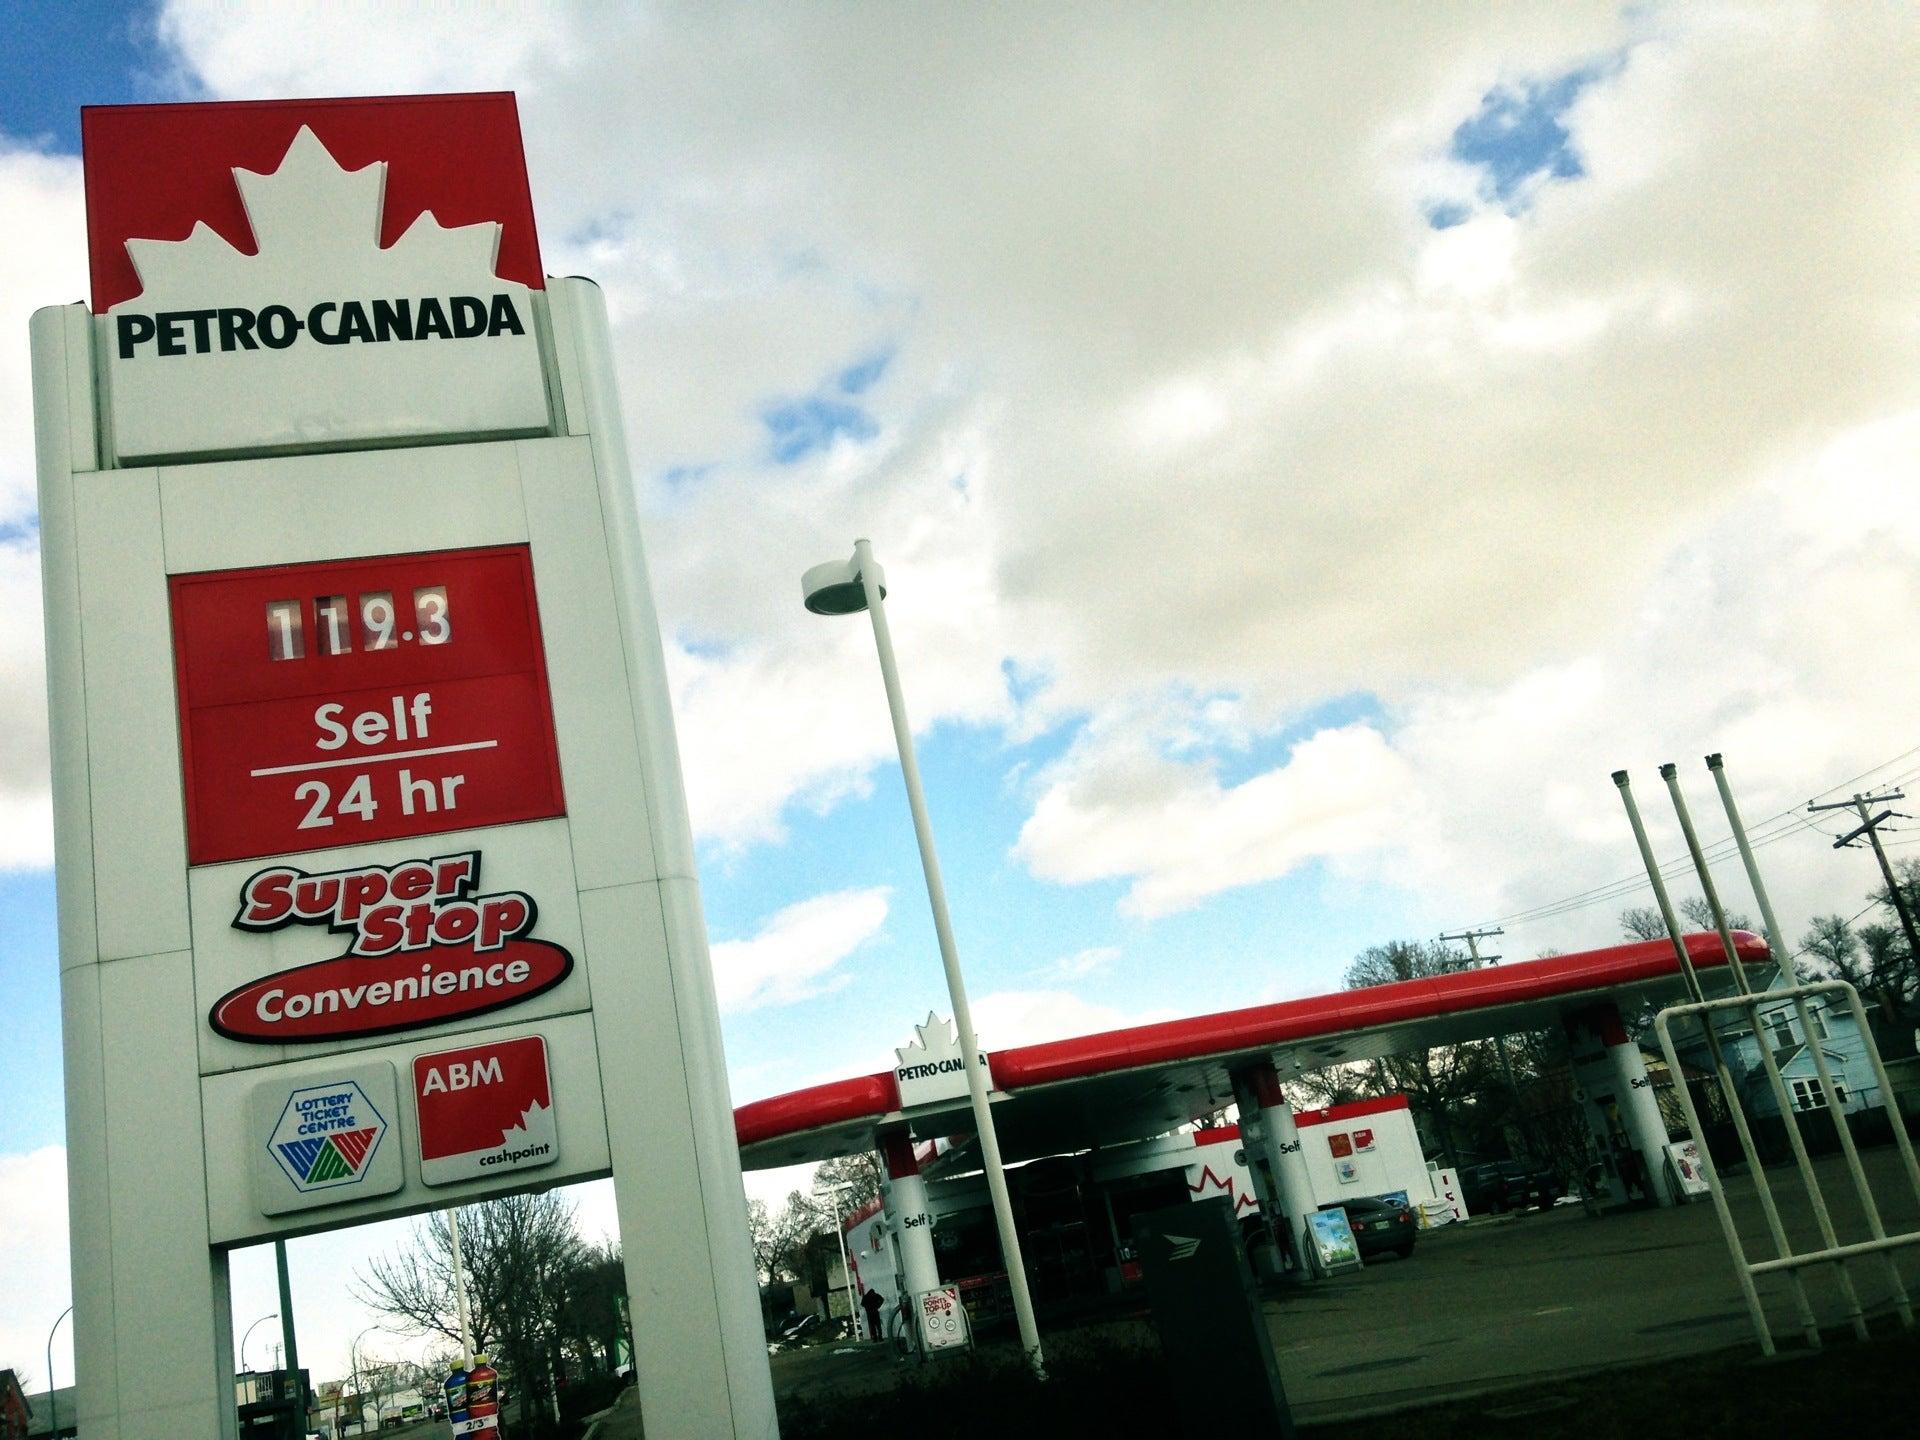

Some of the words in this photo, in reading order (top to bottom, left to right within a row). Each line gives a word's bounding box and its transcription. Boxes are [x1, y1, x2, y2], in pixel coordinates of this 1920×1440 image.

[117, 294, 525, 359] PETRO-CANADA
[272, 593, 450, 660] 119.3
[314, 692, 432, 751] Self
[294, 774, 378, 830] 24
[399, 769, 465, 816] hr
[244, 857, 471, 924] Super
[358, 897, 528, 952] Stop
[256, 959, 530, 1022] Convenience
[423, 1056, 503, 1096] ABM
[295, 1092, 354, 1112] LOTTERY
[301, 1105, 349, 1122] TICKET
[298, 1116, 355, 1135] CENTRE
[479, 1143, 551, 1167] cashpoint
[1280, 1140, 1300, 1155] Self
[904, 1213, 925, 1229] Self
[924, 1297, 947, 1307] POINTS
[925, 1303, 952, 1314] TOP-UP
